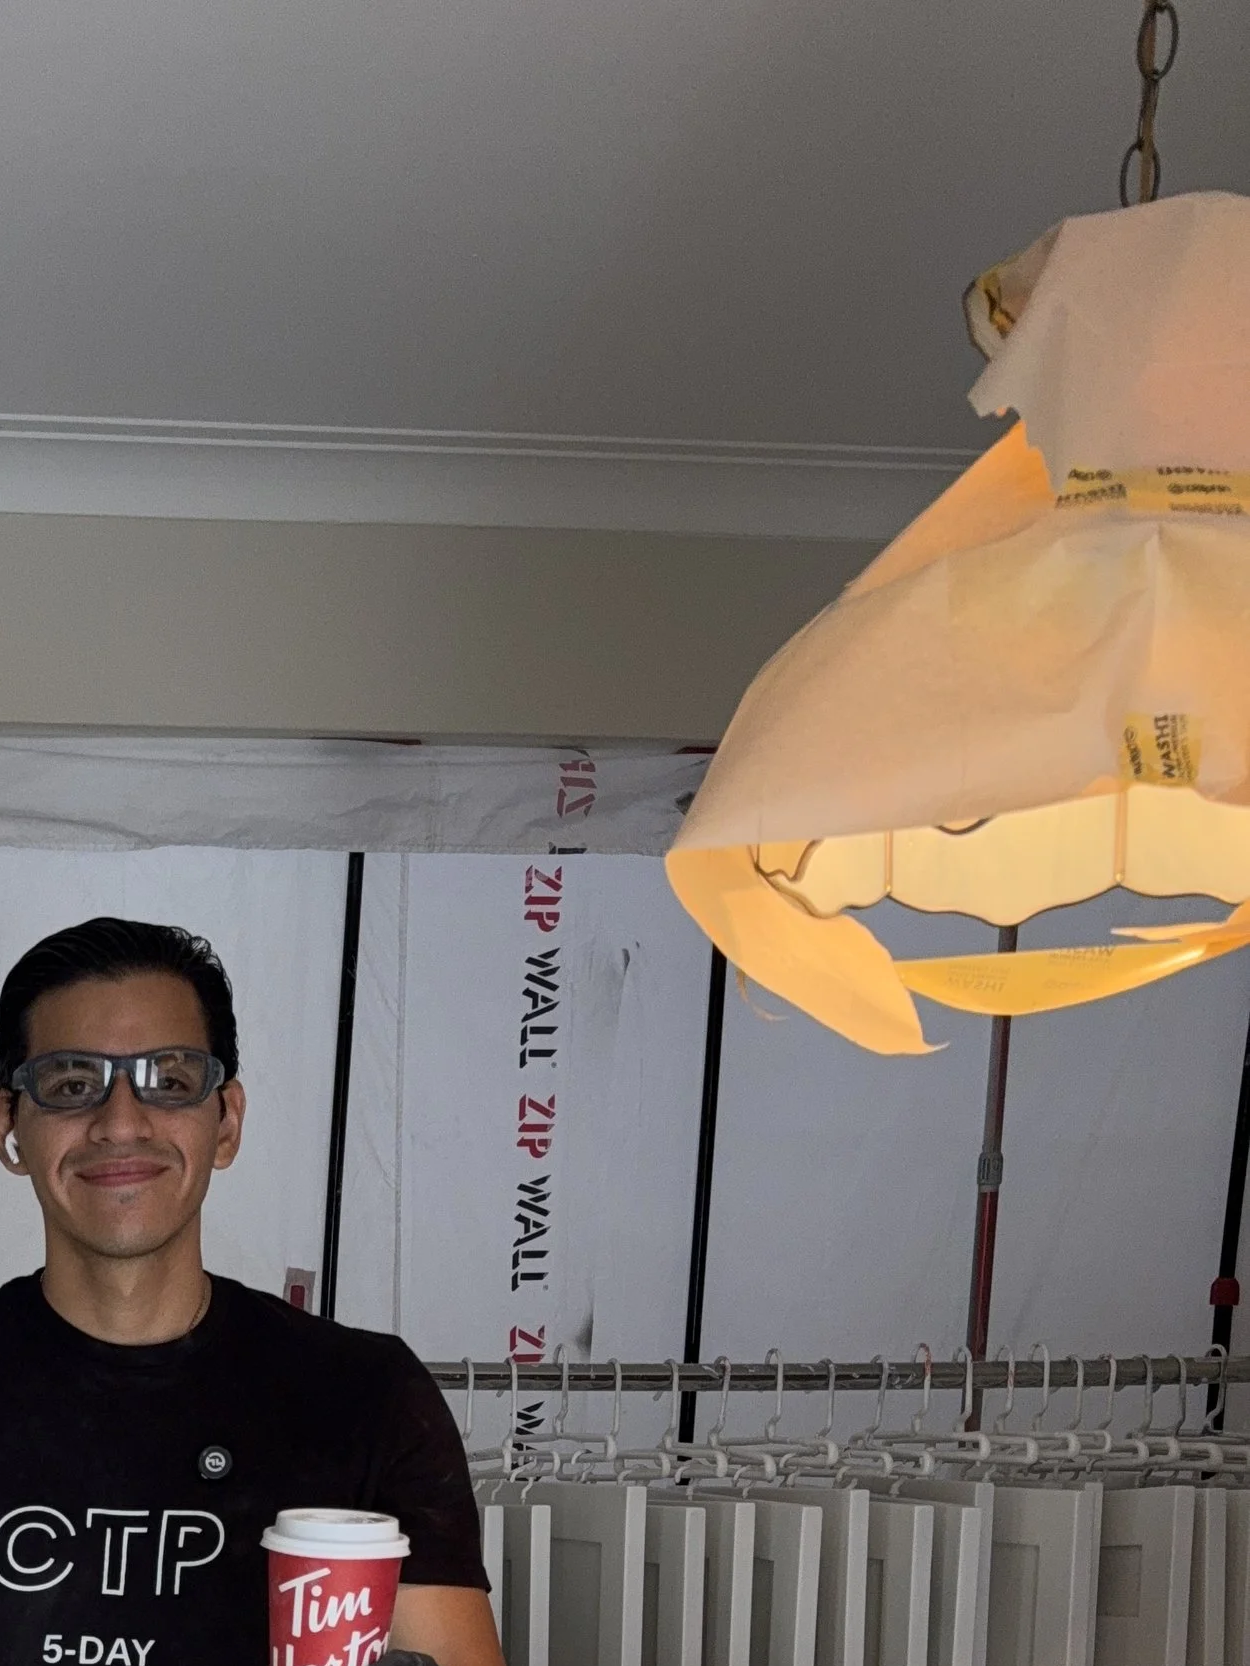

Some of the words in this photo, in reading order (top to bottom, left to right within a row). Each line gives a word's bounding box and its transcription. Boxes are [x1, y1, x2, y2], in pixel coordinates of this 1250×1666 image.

[1154, 714, 1175, 779] WASHI
[524, 864, 563, 933] ZIP
[519, 947, 561, 1069] WALL
[516, 1093, 556, 1159] ZIP
[511, 1174, 551, 1292] WALL
[510, 1325, 546, 1366] ZI
[278, 1567, 372, 1638] Tim
[42, 1634, 156, 1666] 5-DAY
